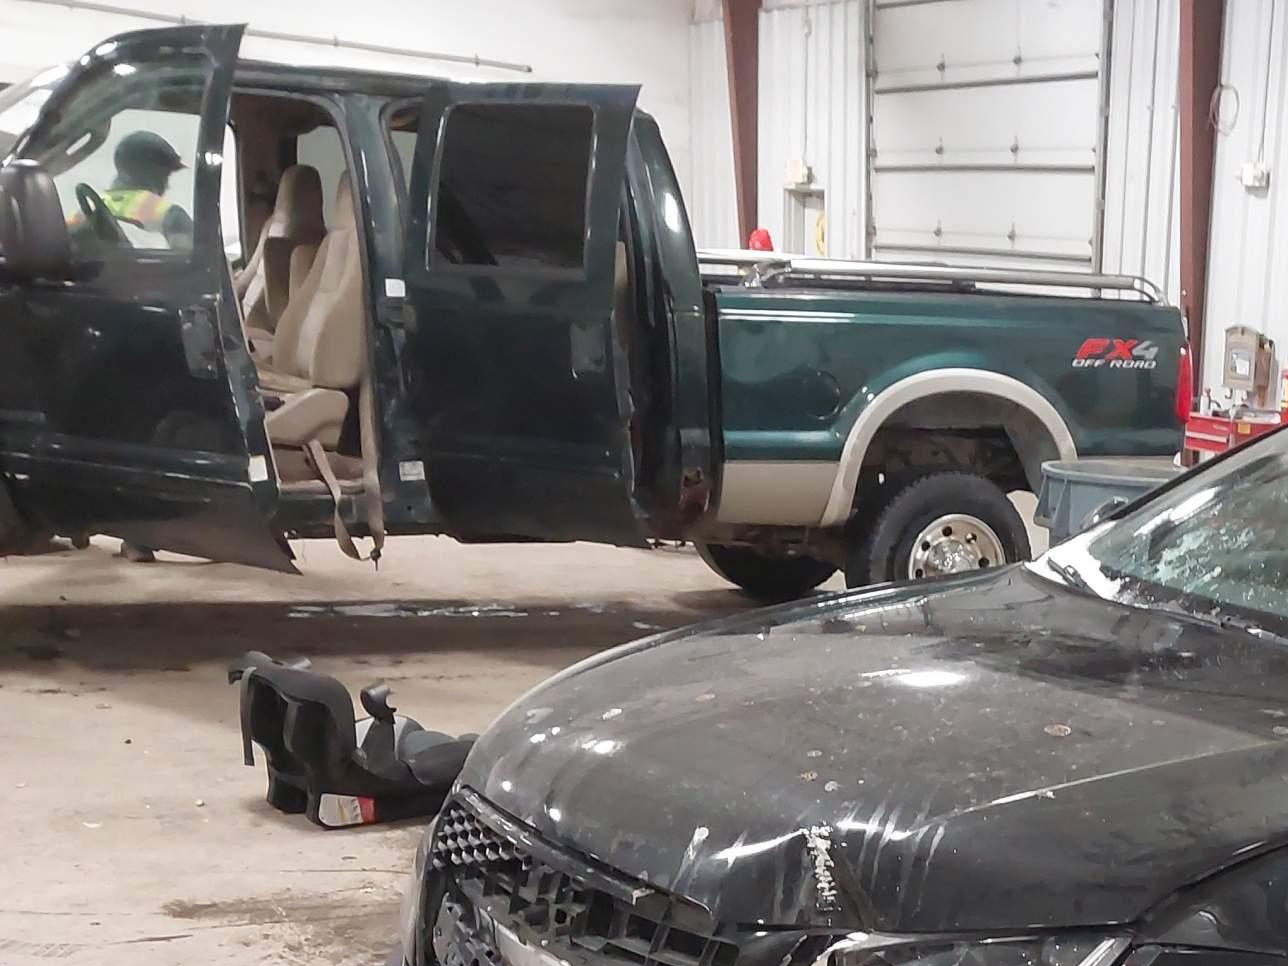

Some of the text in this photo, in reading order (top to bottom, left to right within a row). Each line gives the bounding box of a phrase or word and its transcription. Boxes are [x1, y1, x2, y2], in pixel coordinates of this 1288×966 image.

[1076, 338, 1159, 360] FX4
[1072, 358, 1157, 369] OFF ROAD
